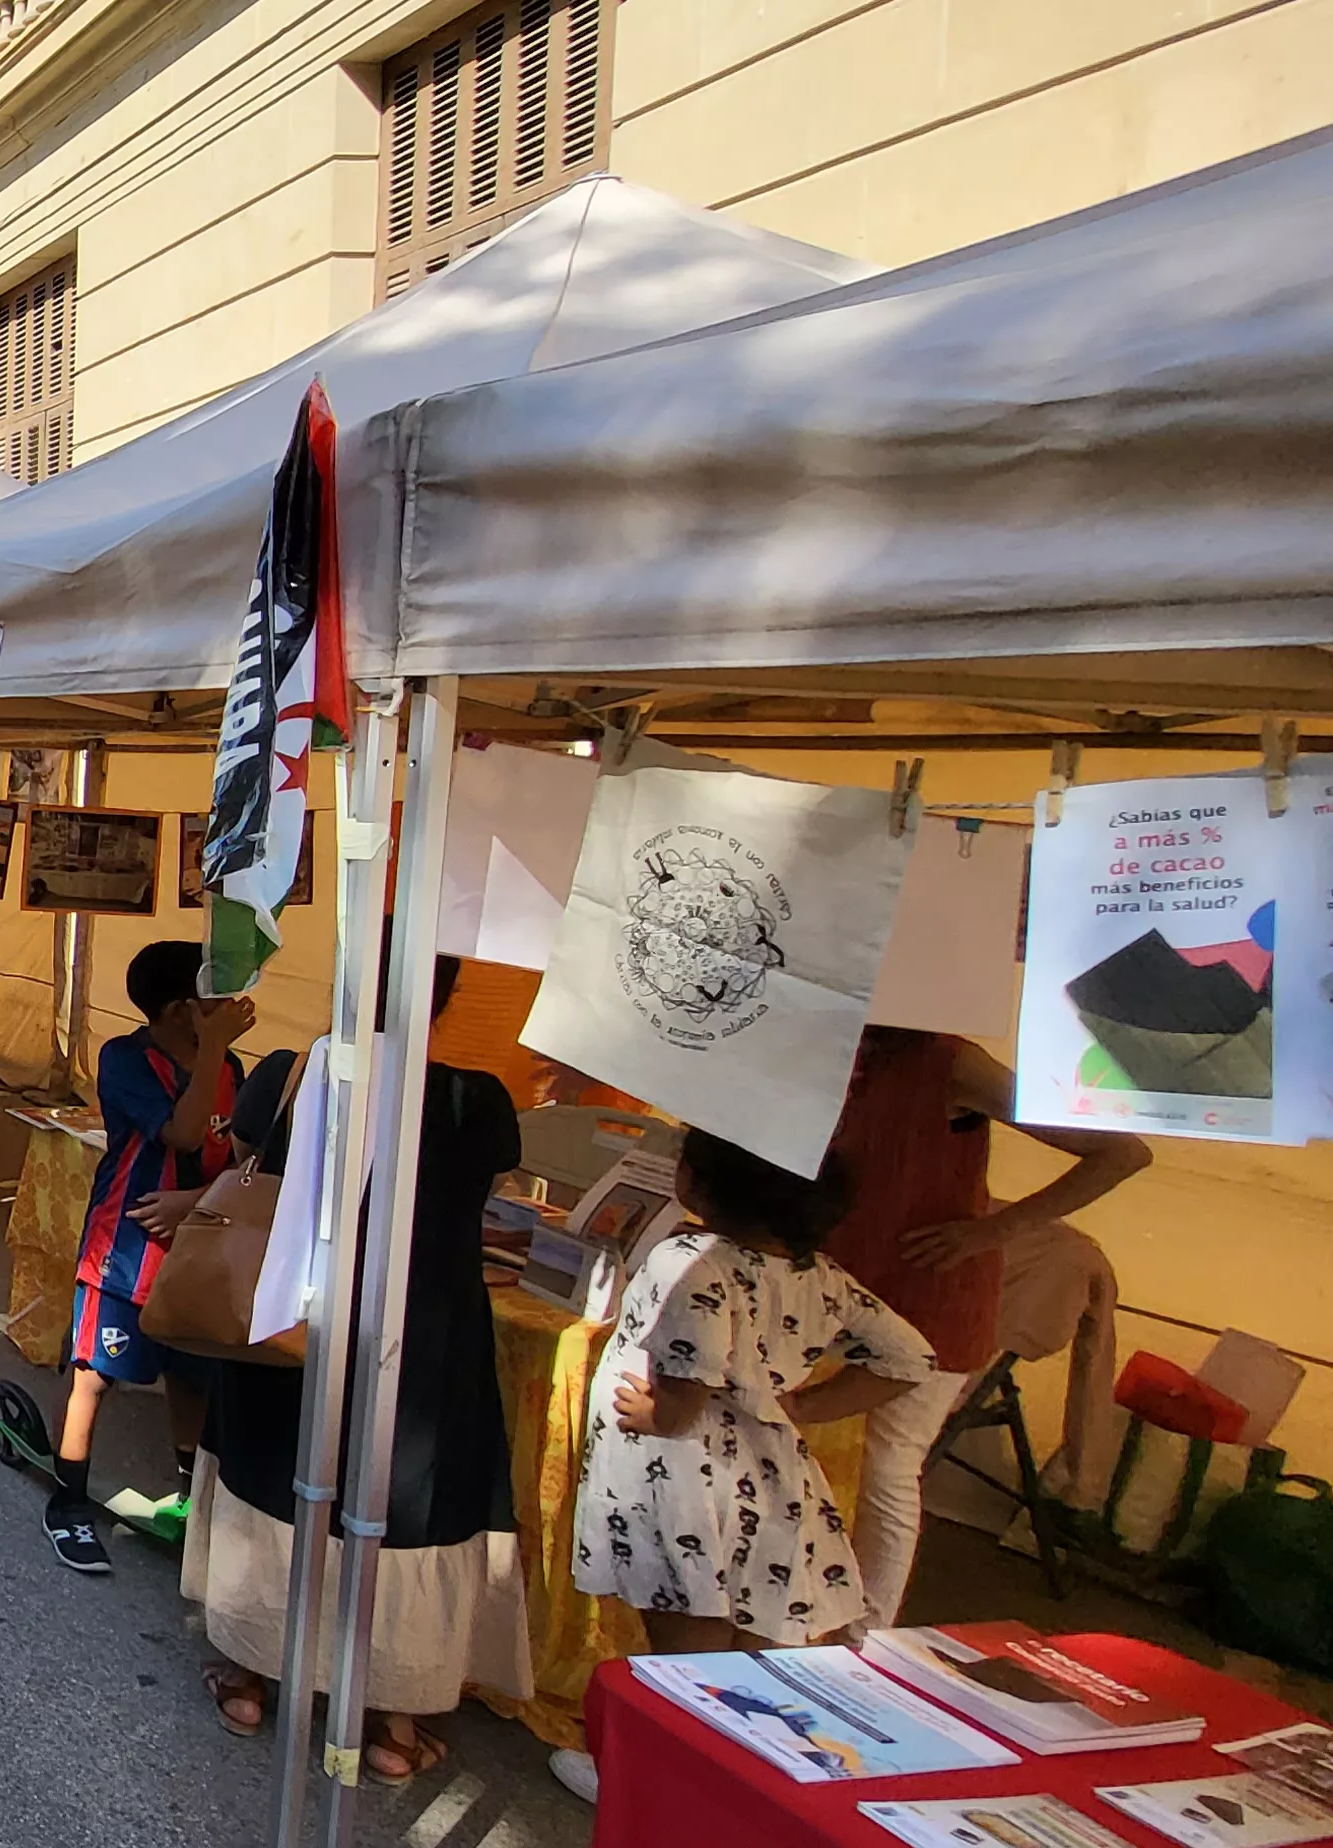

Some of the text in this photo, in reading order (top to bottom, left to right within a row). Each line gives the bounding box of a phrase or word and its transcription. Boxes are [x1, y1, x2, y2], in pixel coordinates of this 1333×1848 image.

[1189, 805, 1227, 821] que
[728, 838, 743, 854] la
[1113, 826, 1223, 850] a más %
[745, 850, 765, 870] con
[1109, 855, 1226, 876] de cacao
[1090, 875, 1244, 895] más beneficios
[1095, 895, 1238, 916] para la salud?
